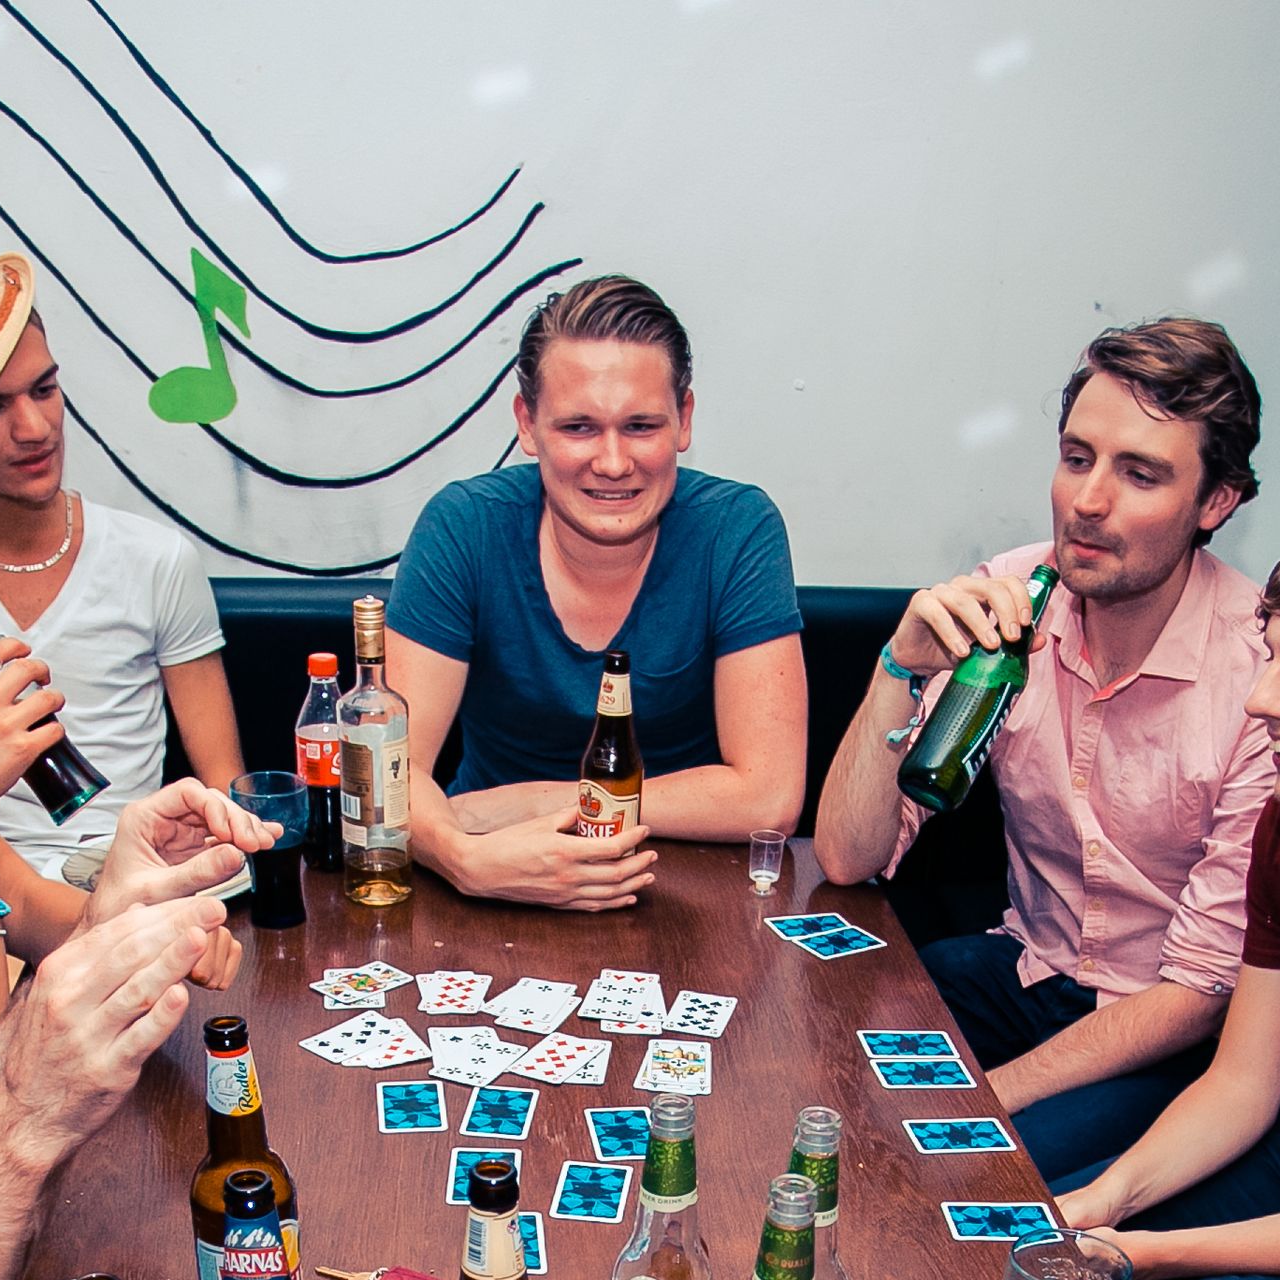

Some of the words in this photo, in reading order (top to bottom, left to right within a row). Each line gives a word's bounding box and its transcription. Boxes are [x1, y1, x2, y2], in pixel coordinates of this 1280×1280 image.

[577, 822, 616, 838] SKIE
[234, 1059, 254, 1112] Radler
[224, 1245, 283, 1274] HARNAŚ
